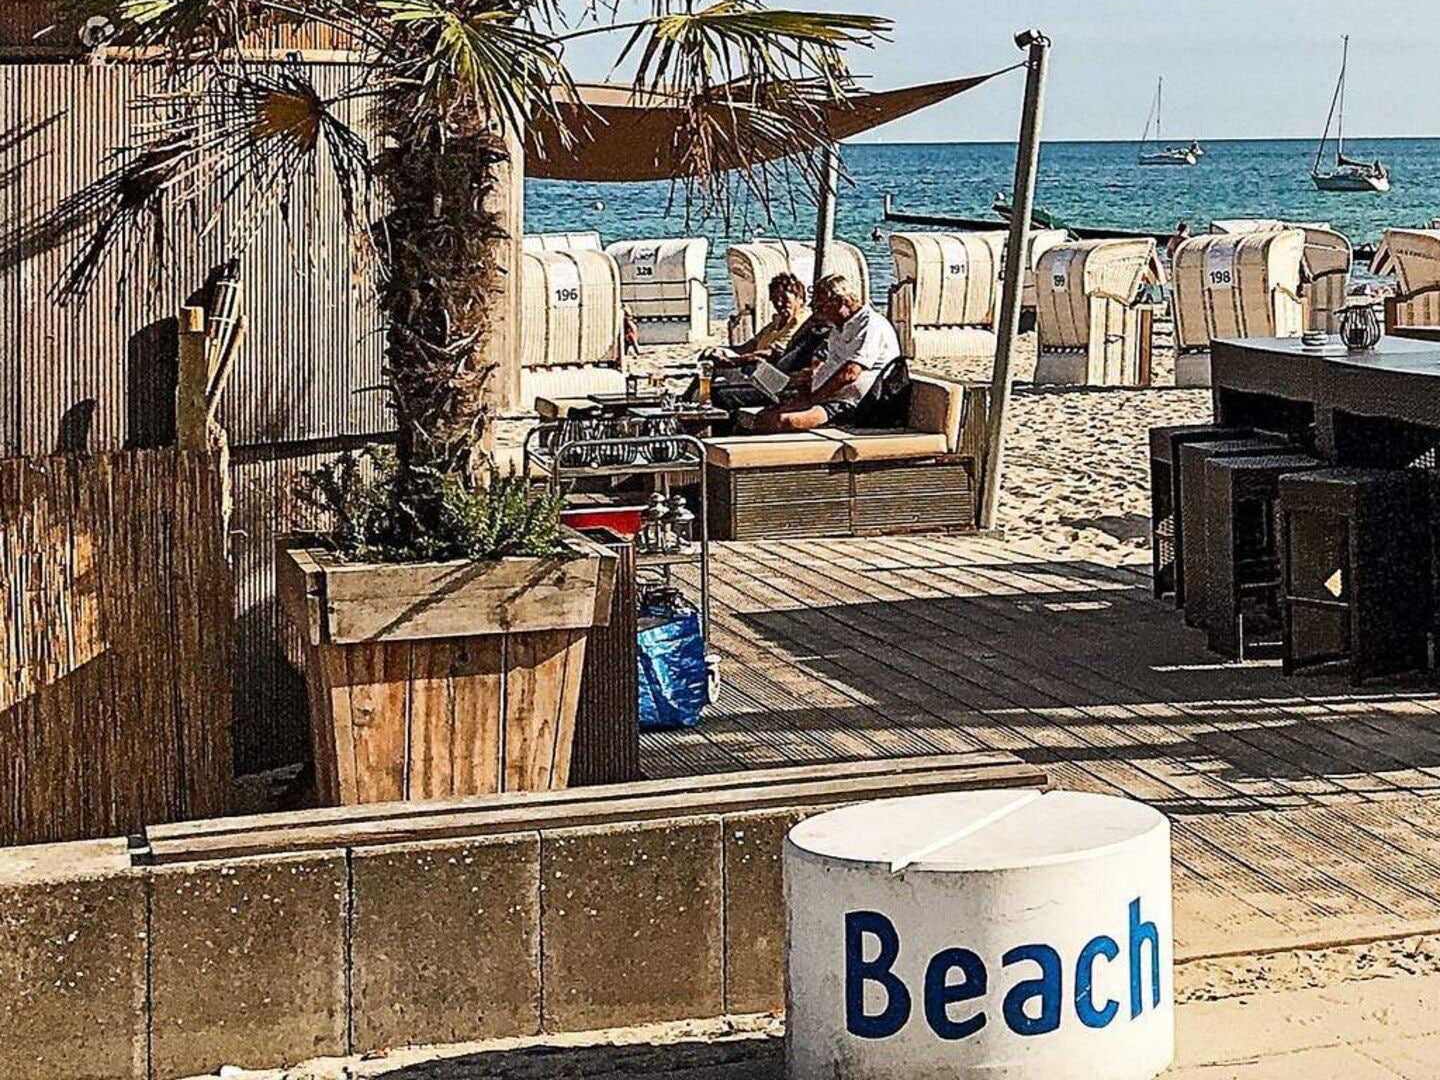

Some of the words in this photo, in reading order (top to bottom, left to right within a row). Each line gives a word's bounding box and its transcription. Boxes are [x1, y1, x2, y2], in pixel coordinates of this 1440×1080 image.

[1209, 270, 1231, 283] 198
[555, 289, 578, 301] 196
[844, 896, 1160, 1040] Beach
